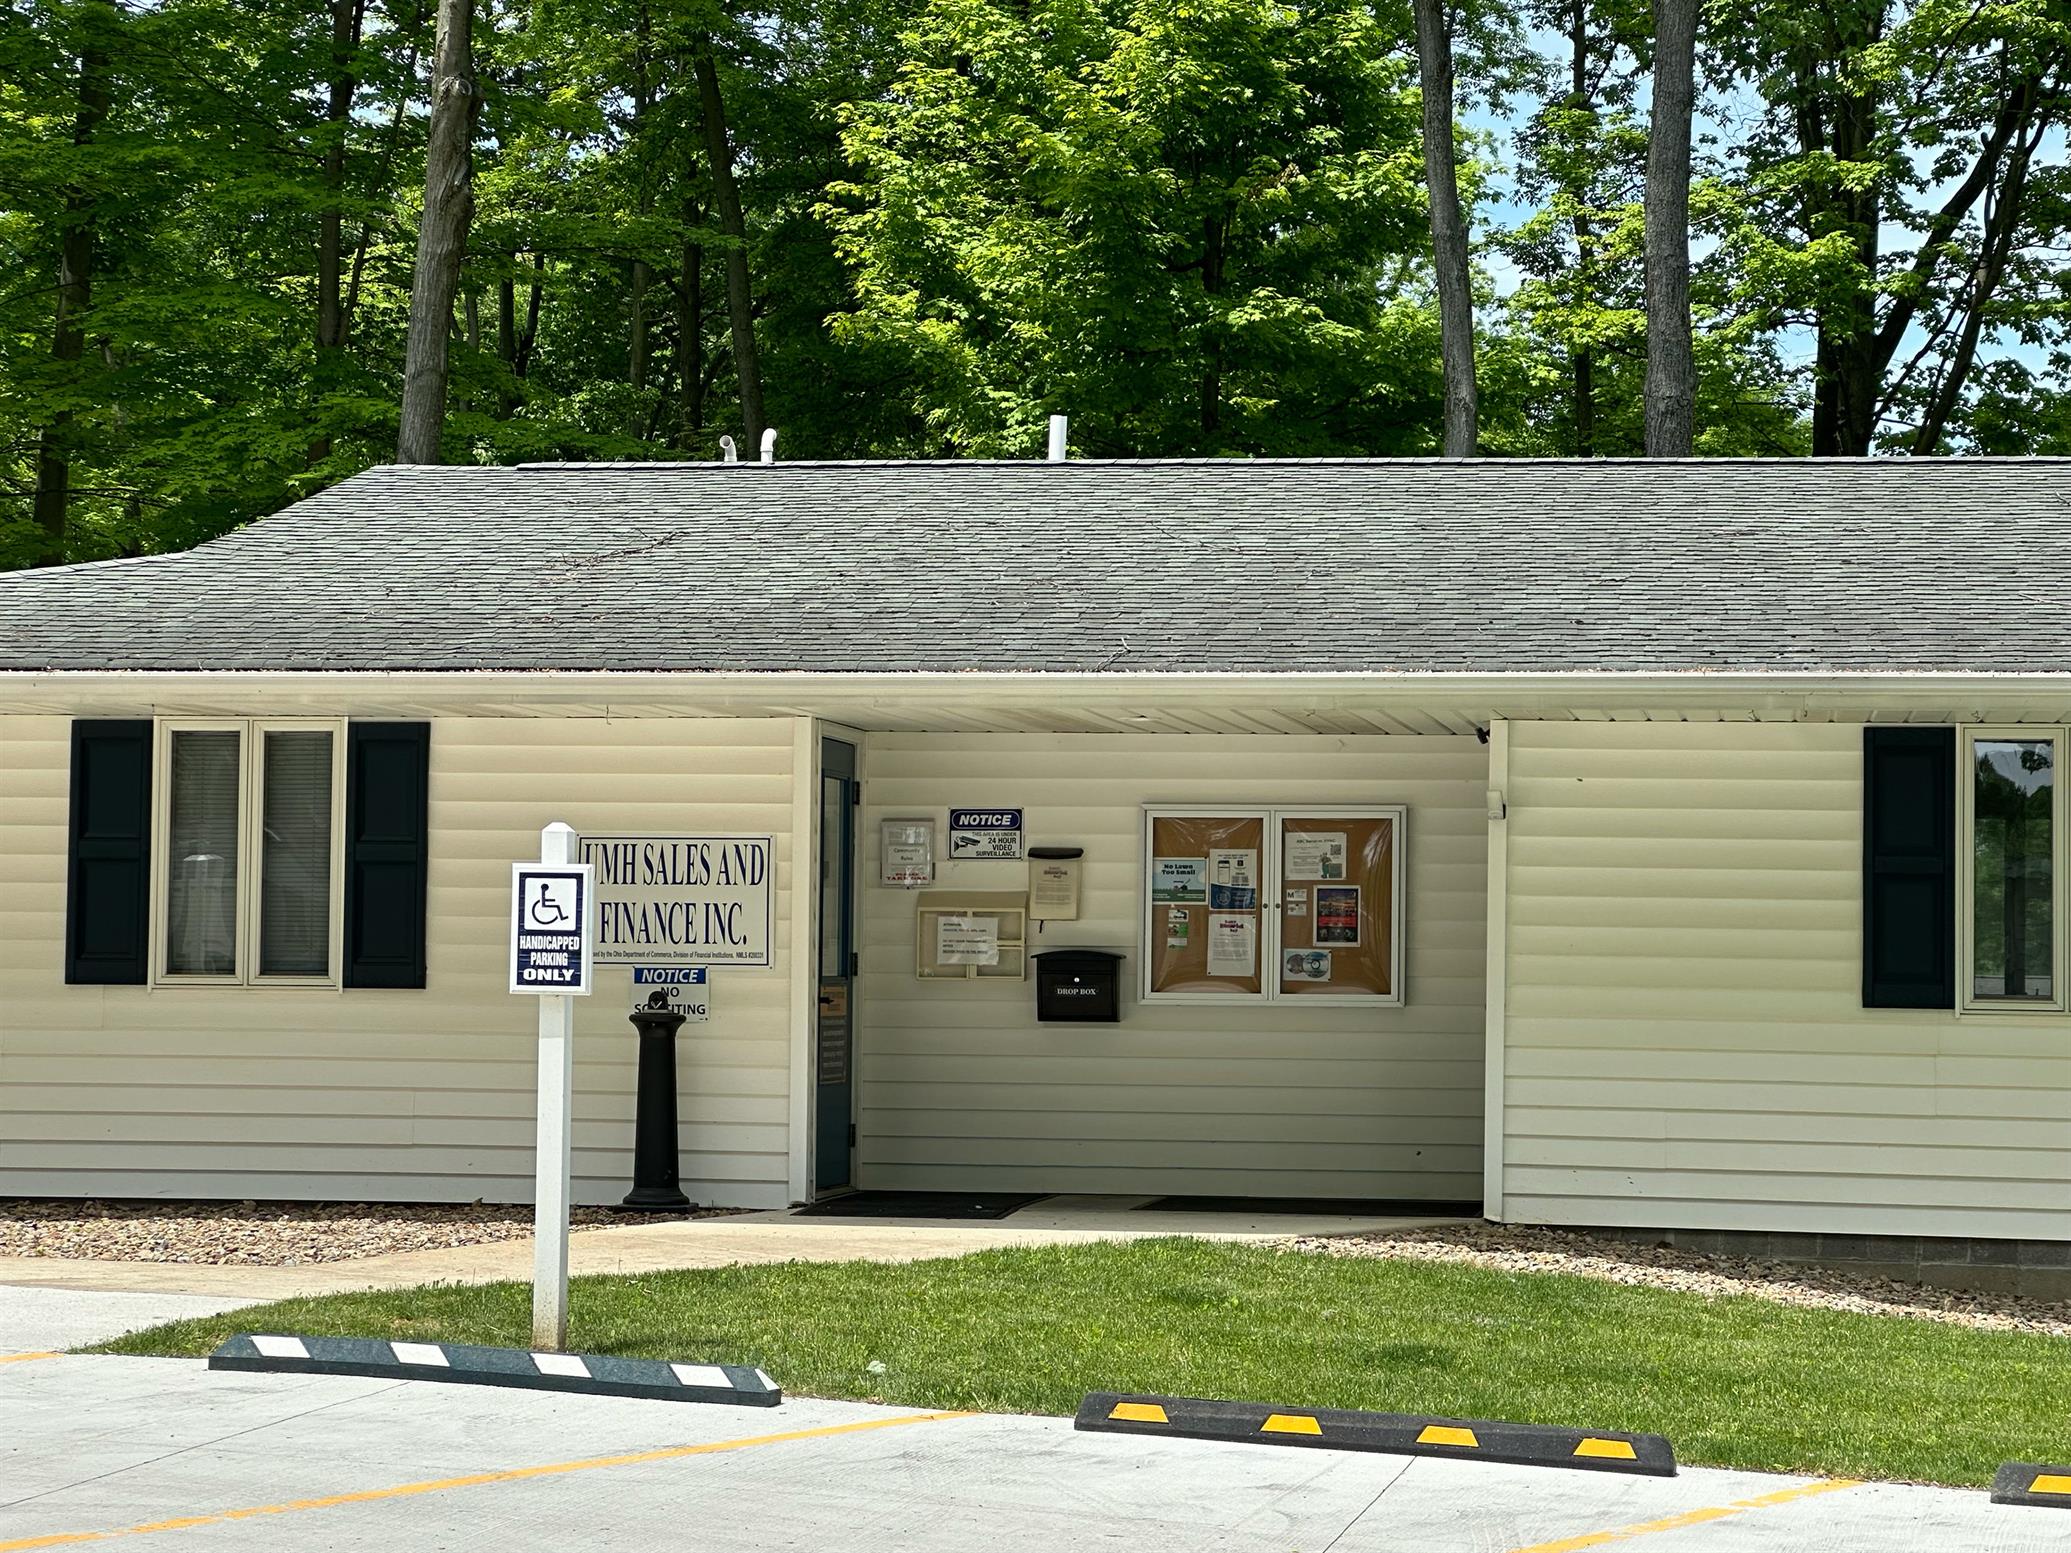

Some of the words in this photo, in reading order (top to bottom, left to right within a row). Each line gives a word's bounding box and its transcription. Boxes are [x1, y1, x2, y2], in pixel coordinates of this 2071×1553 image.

[959, 814, 1012, 825] NOTICE
[584, 843, 638, 885] UMH
[642, 843, 711, 886] SALES
[716, 843, 765, 886] AND
[600, 901, 697, 944] FINANCE
[703, 902, 747, 945] INC.
[519, 935, 580, 950] HANDICAPPED
[530, 951, 569, 966] PARKING
[523, 968, 575, 981] ONLY
[641, 969, 699, 983] NOTICE
[660, 986, 680, 997] NO
